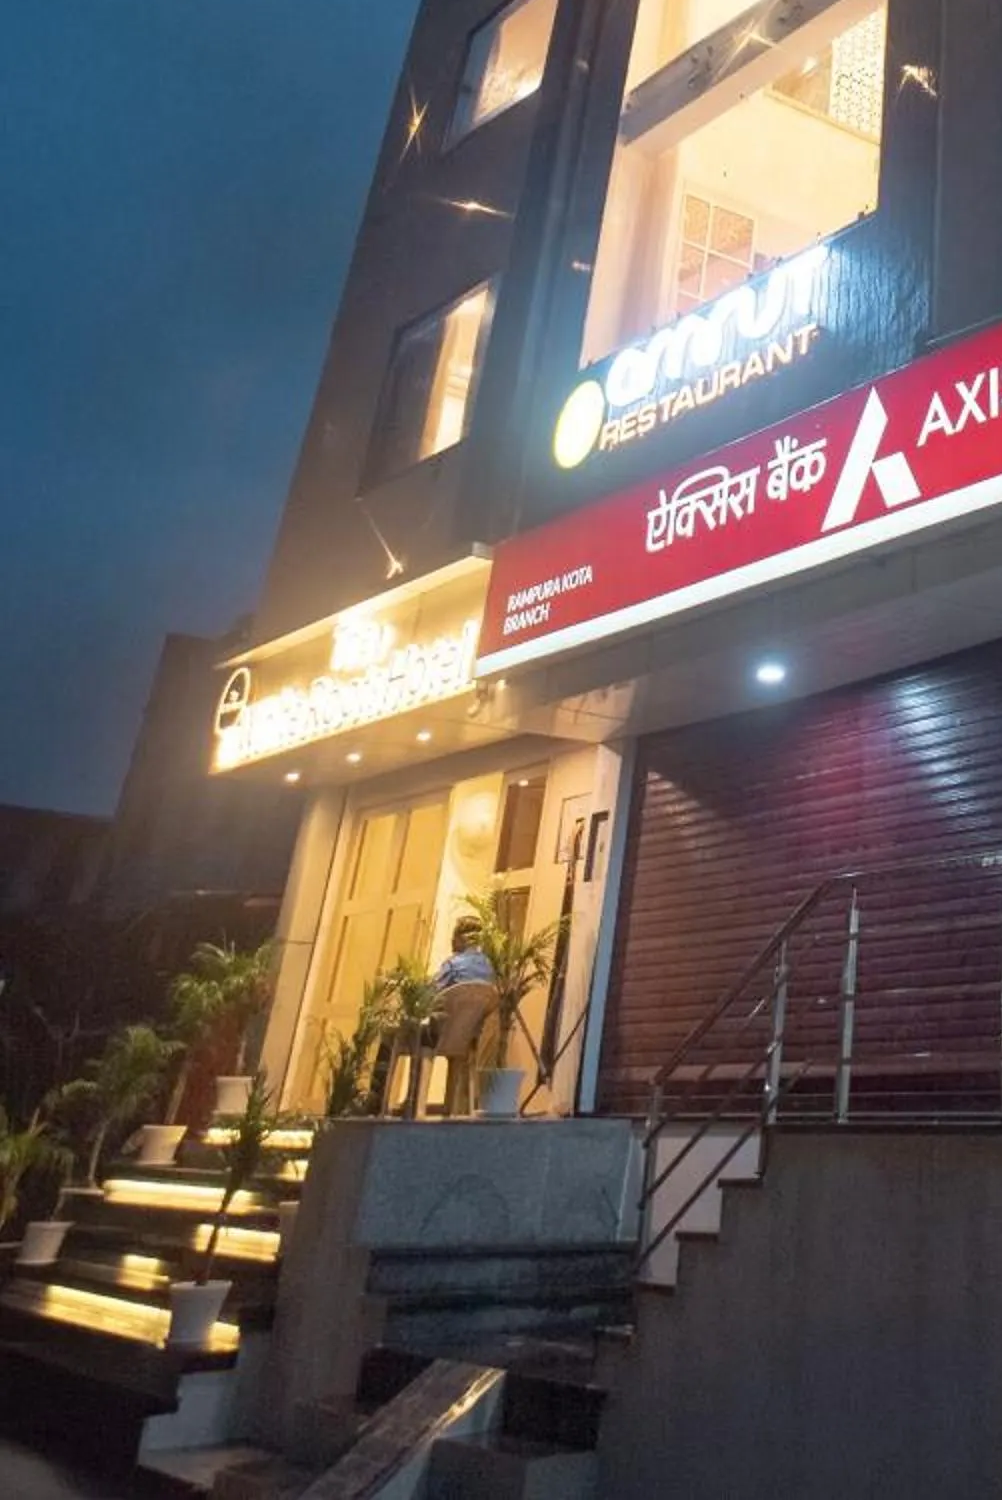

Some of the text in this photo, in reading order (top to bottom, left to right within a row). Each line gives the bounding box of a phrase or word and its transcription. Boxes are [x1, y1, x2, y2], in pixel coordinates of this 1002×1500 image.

[600, 324, 819, 450] RESTAURANT
[645, 435, 827, 553] ऐक्सिस बैंक
[503, 602, 551, 636] BRANCH
[507, 565, 593, 613] RAMPURA KOTA
